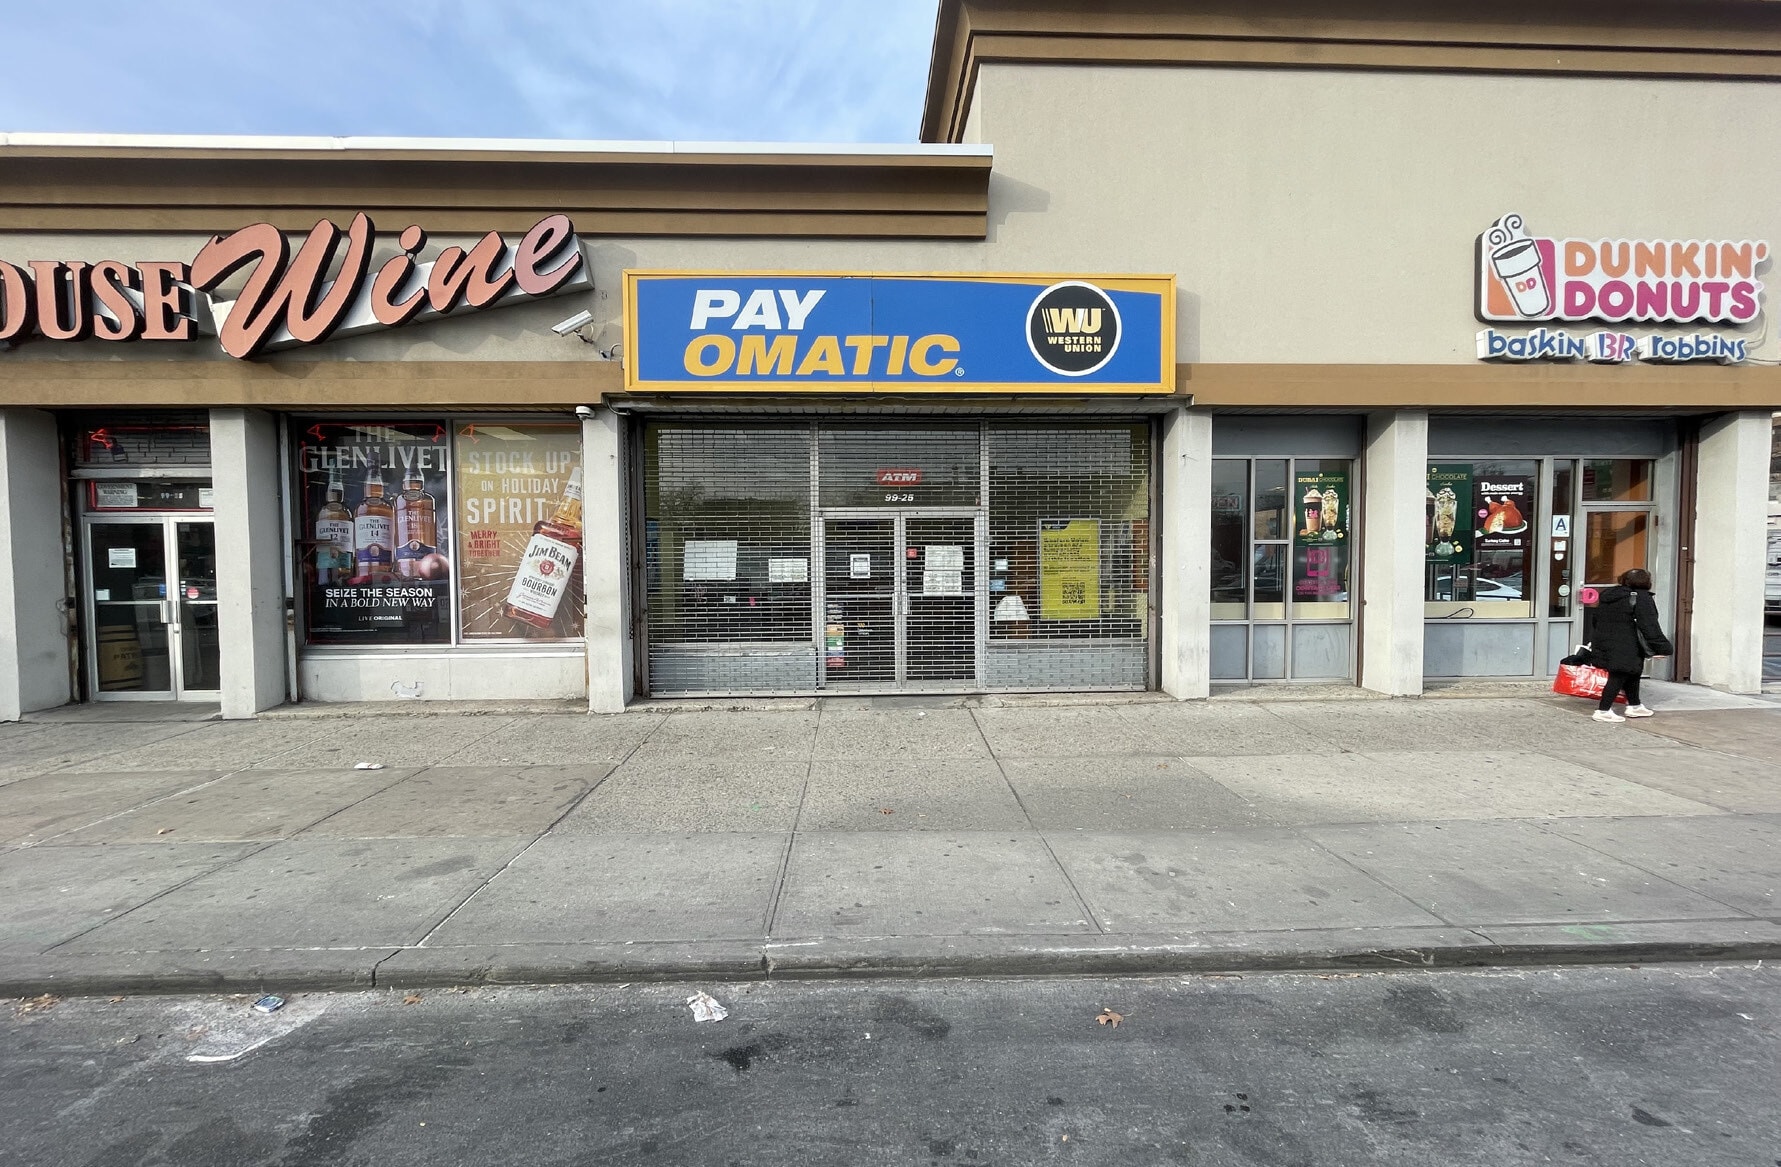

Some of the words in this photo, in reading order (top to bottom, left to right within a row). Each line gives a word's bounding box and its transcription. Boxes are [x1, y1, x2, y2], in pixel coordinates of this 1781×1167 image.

[1564, 240, 1767, 279] DUNKIN'
[190, 211, 583, 359] Wine
[1515, 277, 1537, 293] DD
[1564, 280, 1756, 319] DONUTS
[690, 289, 827, 330] PAY
[1046, 308, 1102, 334] WU
[1047, 336, 1102, 345] WESTERN
[1064, 344, 1102, 352] UNION
[1600, 333, 1635, 359] BR
[683, 334, 961, 377] OMATIC
[355, 426, 396, 443] THE
[468, 451, 535, 475] STOCK
[545, 451, 572, 474] UP
[881, 473, 917, 481] ATM
[481, 480, 494, 492] ON
[502, 478, 559, 494] HOLIDAY
[1480, 482, 1524, 491] Dessert
[885, 494, 914, 502] 99-25
[466, 497, 547, 524] SPIRIT
[360, 523, 390, 531] GLENLIVET
[1555, 518, 1566, 531] A
[470, 530, 498, 540] MERRY
[474, 540, 501, 549] BRIGHT
[468, 549, 501, 557] TOGETHER
[528, 544, 548, 558] JIM
[548, 546, 572, 572] BEAM
[325, 588, 358, 598] SEIZE
[360, 588, 383, 597] THE
[386, 587, 433, 597] SEASON
[521, 577, 558, 597] BOURBON
[325, 598, 339, 608] IN
[340, 599, 349, 608] A
[350, 598, 380, 608] BOLD
[382, 597, 409, 608] NEW
[411, 597, 436, 608] WAY
